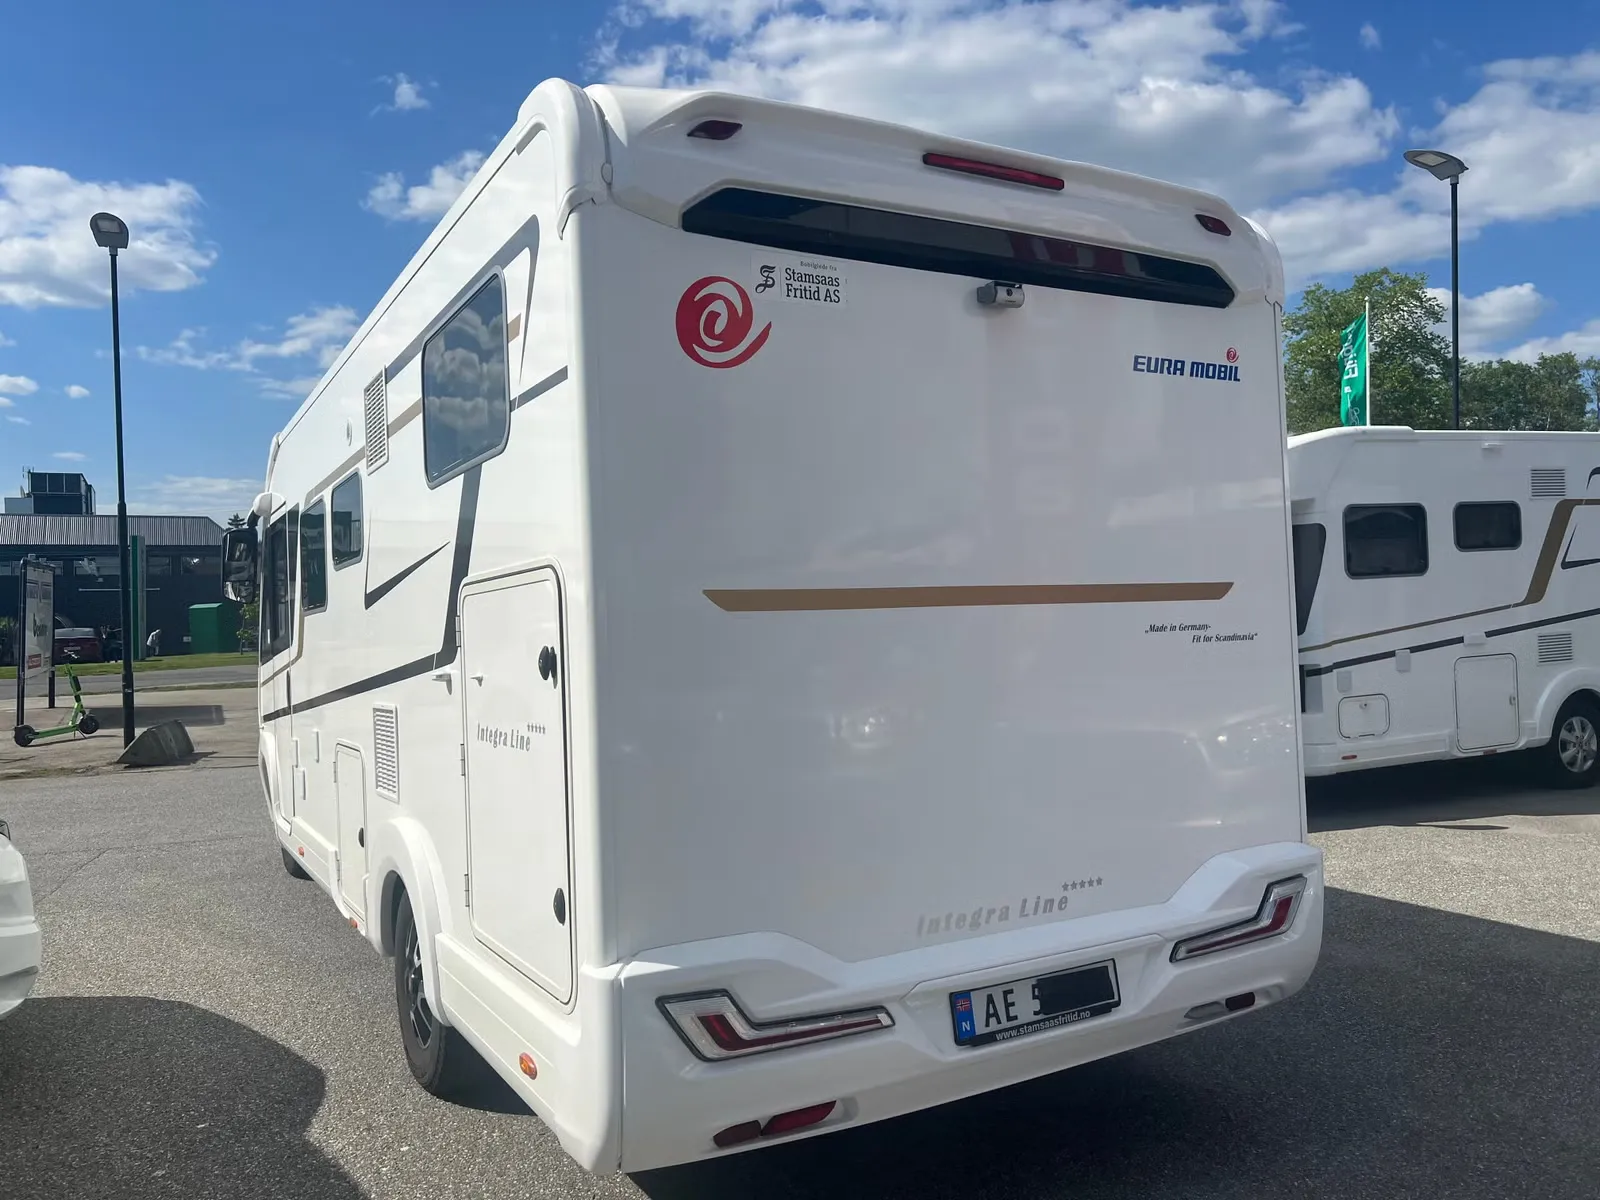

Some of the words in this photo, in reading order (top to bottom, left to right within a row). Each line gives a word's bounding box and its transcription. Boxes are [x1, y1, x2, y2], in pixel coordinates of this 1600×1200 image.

[785, 267, 840, 287] Stamsaas
[786, 283, 821, 301] Fritid
[823, 289, 841, 303] AS
[1133, 355, 1185, 376] EURA
[1189, 361, 1241, 382] MOBIL
[1169, 623, 1177, 632] in
[1192, 634, 1202, 643] Fit
[1202, 634, 1213, 643] for
[477, 722, 508, 748] Integra
[510, 729, 531, 752] Line
[917, 904, 1010, 937] Integra
[1019, 895, 1068, 919] Line
[984, 988, 1018, 1028] AE
[961, 1020, 971, 1032] N
[995, 1010, 1091, 1041] www.stamsaasfritid.no
